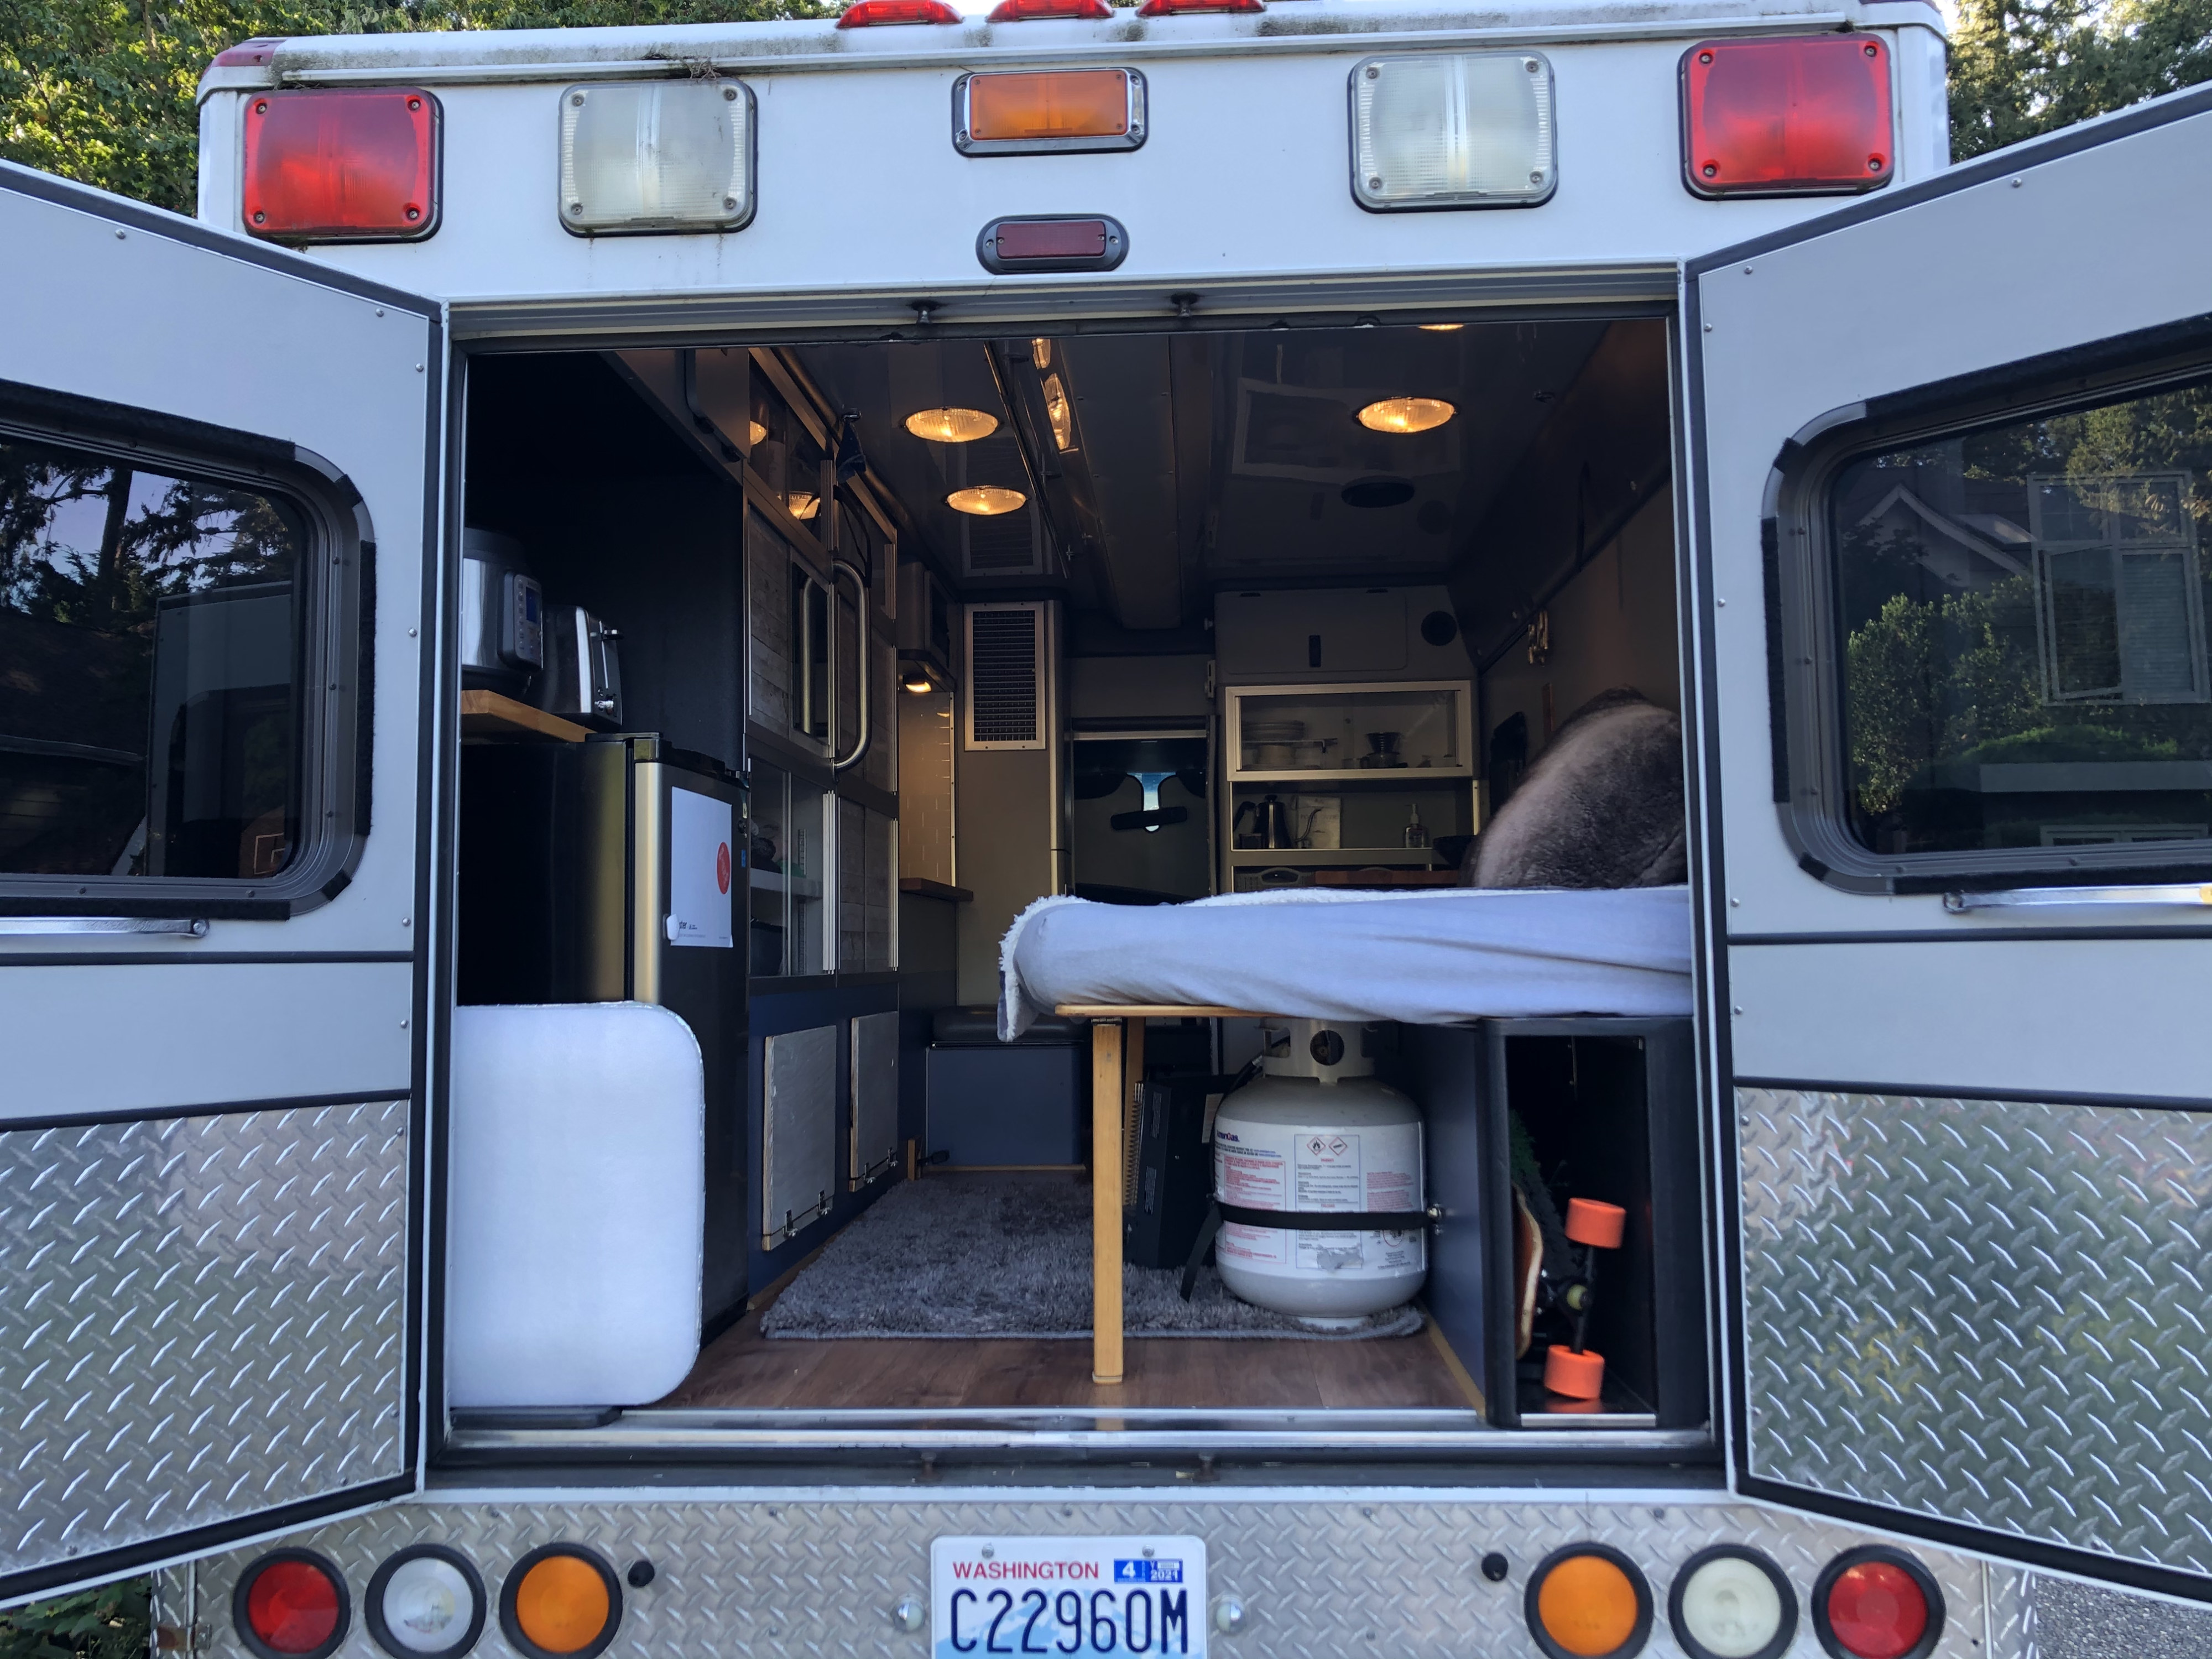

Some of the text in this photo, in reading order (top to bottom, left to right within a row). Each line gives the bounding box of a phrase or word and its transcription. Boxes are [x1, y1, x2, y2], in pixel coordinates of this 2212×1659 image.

[952, 1561, 1099, 1580] WASHINGTON
[1123, 1561, 1136, 1578] 4
[1150, 1569, 1178, 1581] 2021
[950, 1588, 1188, 1654] C22960M
